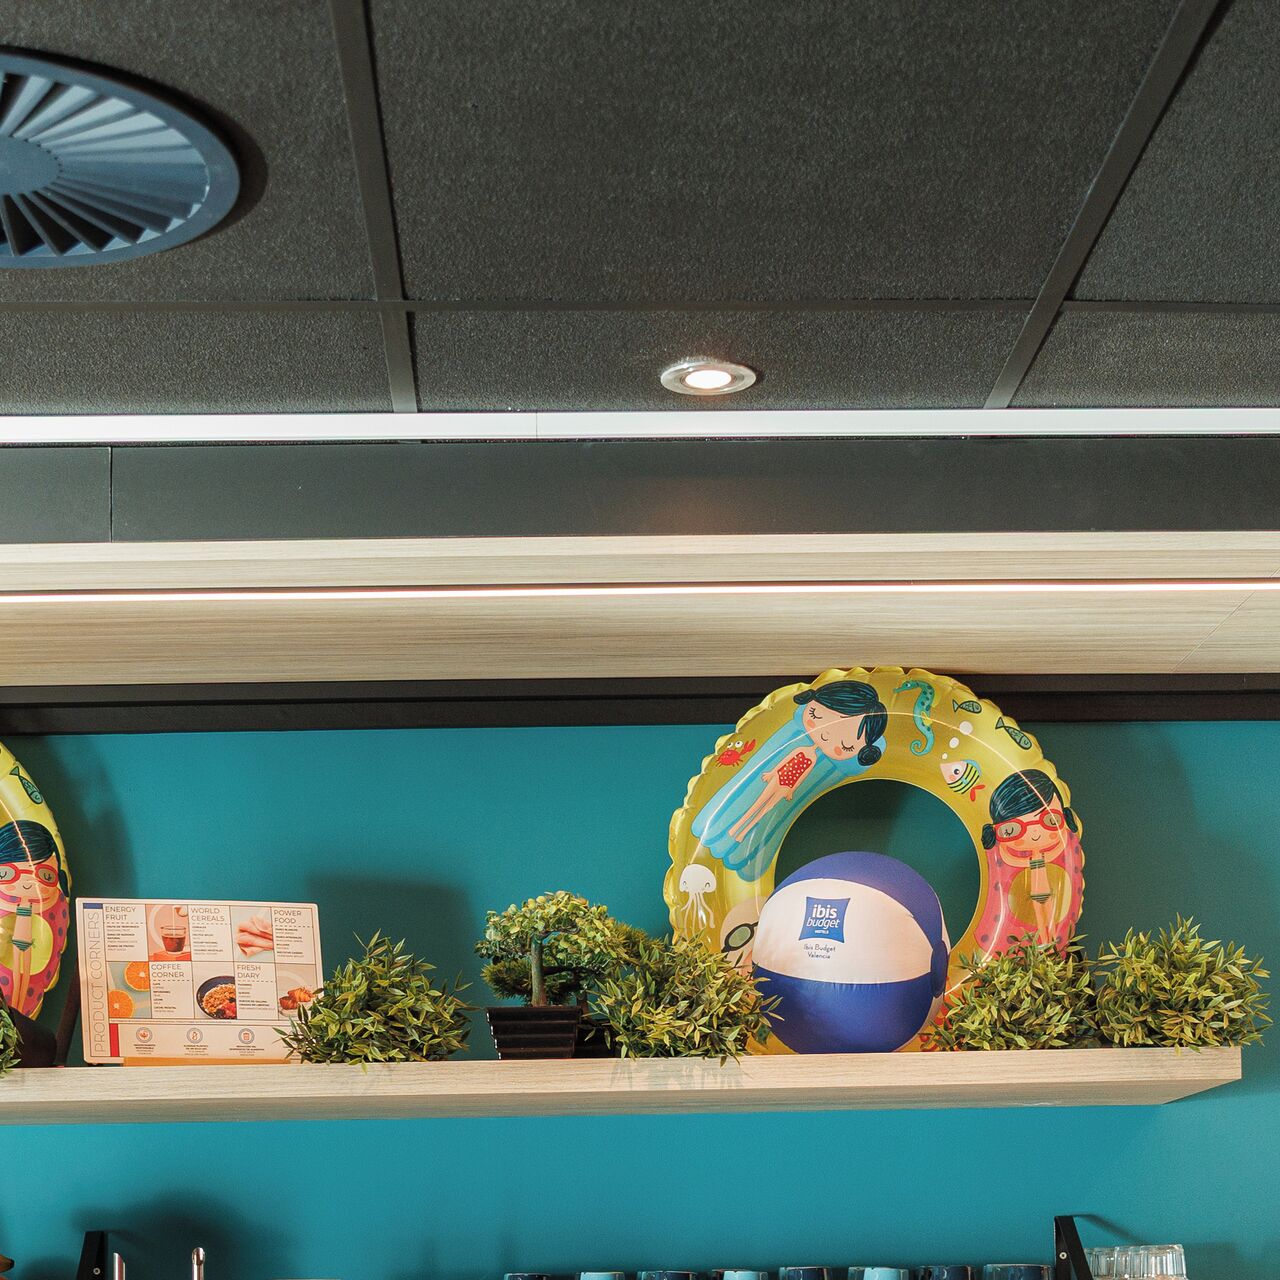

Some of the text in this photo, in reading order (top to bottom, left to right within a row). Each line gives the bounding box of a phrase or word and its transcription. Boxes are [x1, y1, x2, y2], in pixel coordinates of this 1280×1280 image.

[812, 904, 838, 919] ibis
[806, 917, 841, 929] budget
[814, 943, 836, 952] Budget
[807, 951, 831, 959] Valencia
[87, 912, 107, 1052] PRODUCT CORNERS
